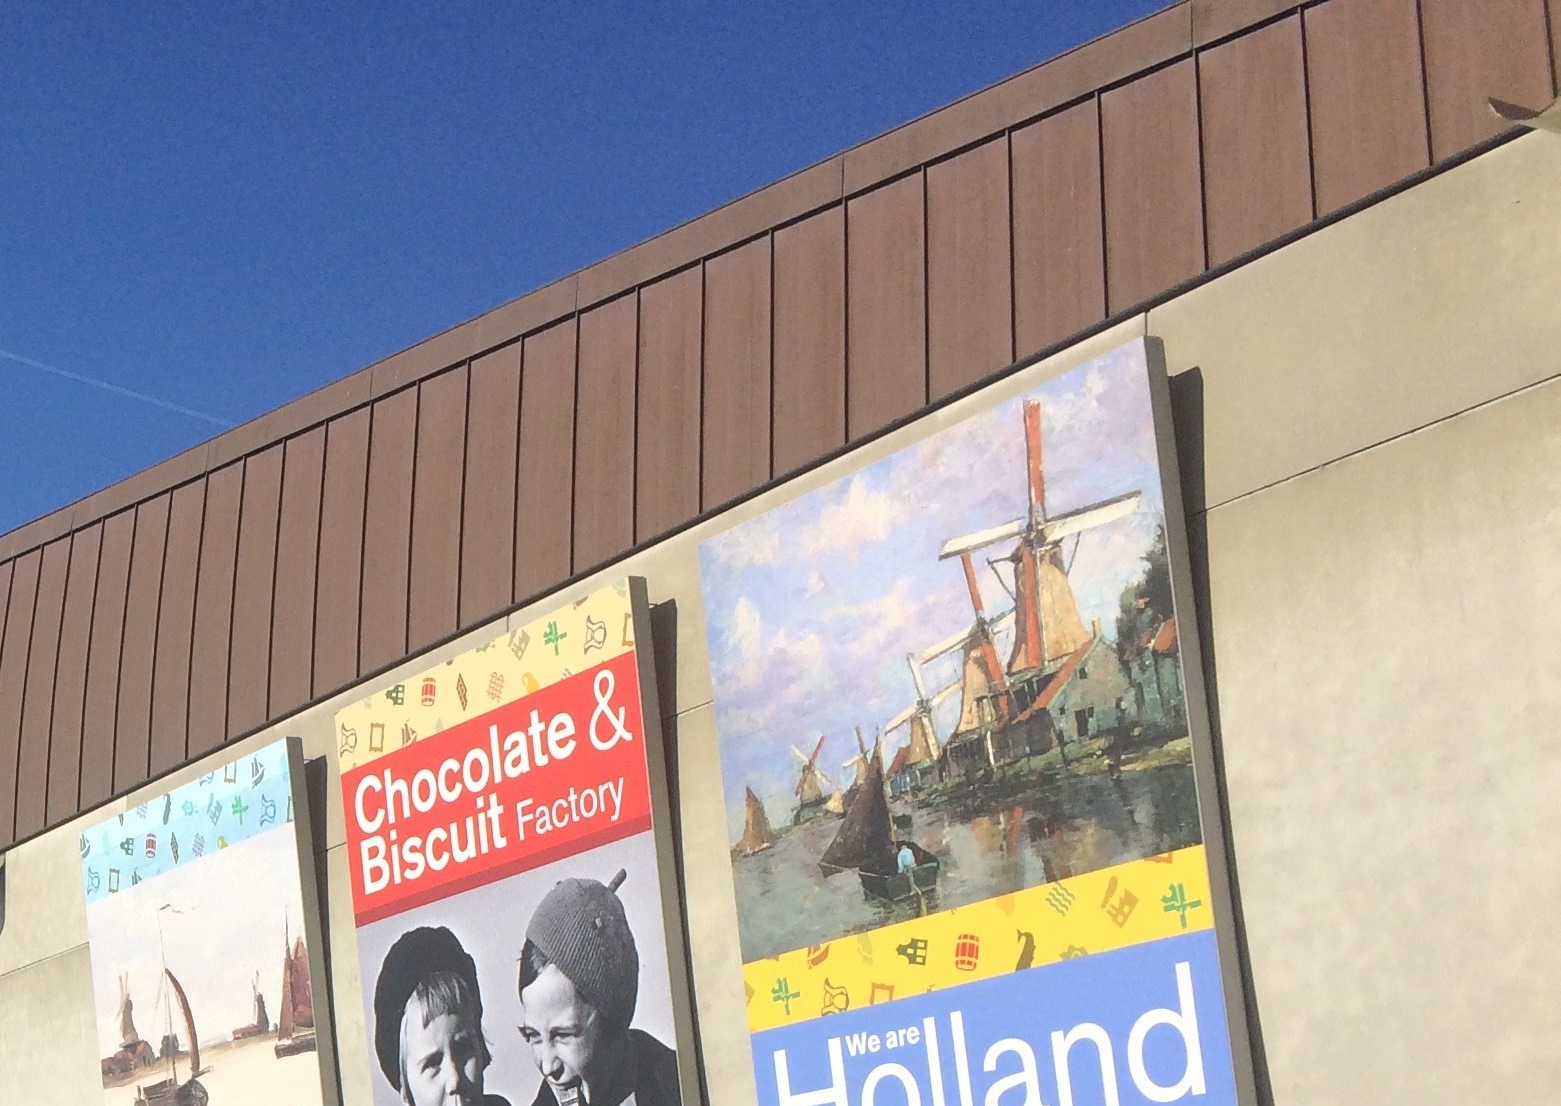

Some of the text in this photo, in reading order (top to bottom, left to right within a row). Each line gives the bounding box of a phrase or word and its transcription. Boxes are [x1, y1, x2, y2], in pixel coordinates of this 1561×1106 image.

[355, 669, 633, 834] Chocolate &
[360, 776, 625, 895] Biscuit Factory
[846, 1025, 920, 1057] We are
